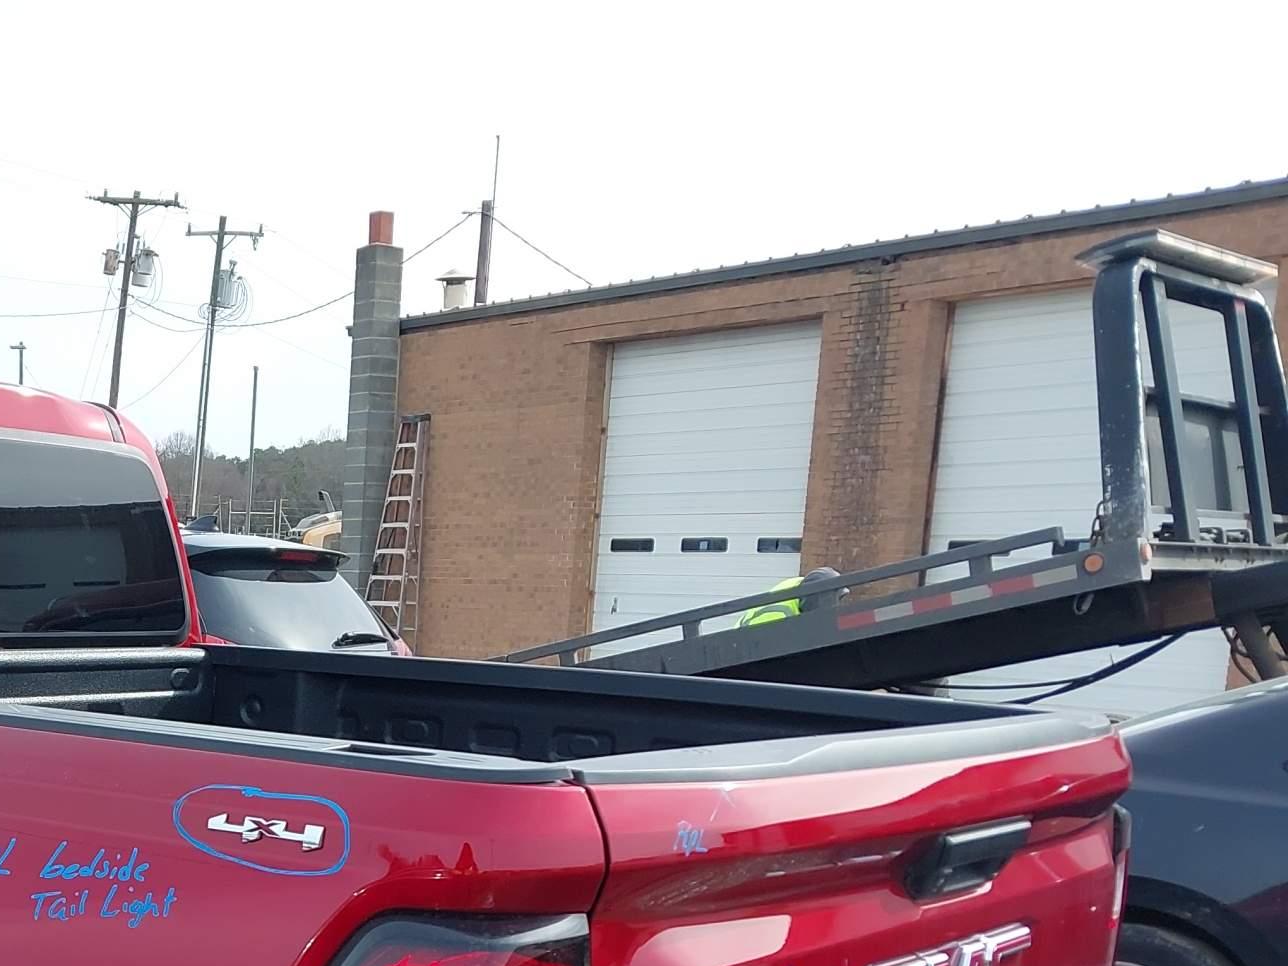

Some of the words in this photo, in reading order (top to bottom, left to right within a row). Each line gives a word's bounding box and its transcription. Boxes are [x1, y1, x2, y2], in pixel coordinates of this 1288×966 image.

[39, 840, 150, 882] bedside
[30, 889, 89, 921] Tail
[100, 884, 178, 928] Light
